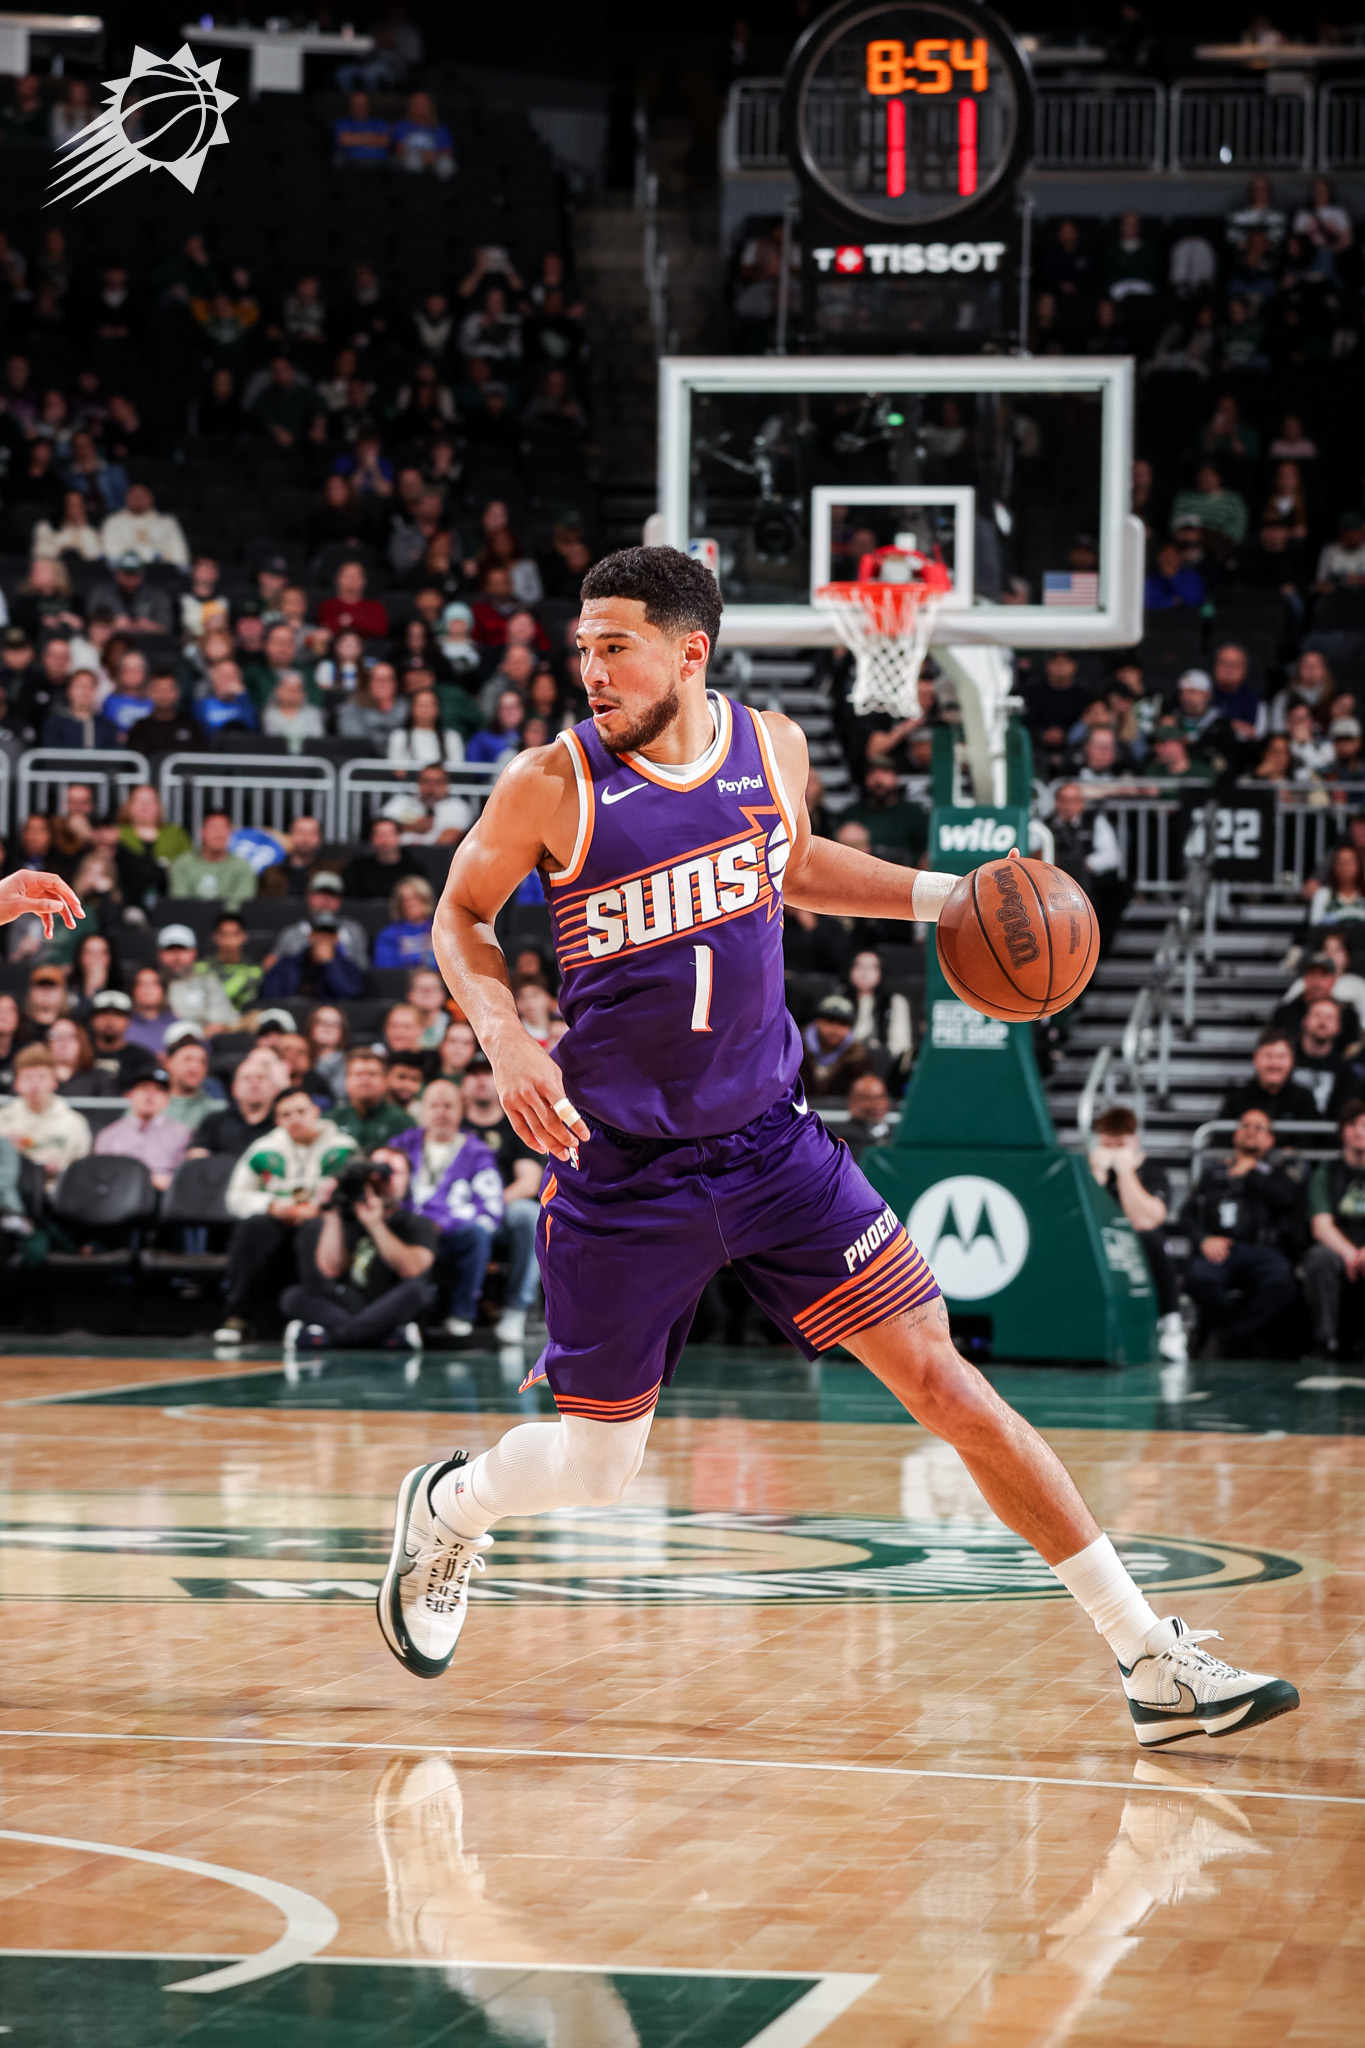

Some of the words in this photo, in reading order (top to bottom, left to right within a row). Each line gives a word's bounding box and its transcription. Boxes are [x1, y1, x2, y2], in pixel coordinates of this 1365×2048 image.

[866, 38, 989, 95] 8:54
[887, 98, 977, 198] 11
[863, 242, 1006, 274] TISSOT
[717, 775, 763, 795] PayPal
[939, 818, 1017, 852] wilo
[993, 866, 1040, 970] Wilson
[691, 944, 713, 1032] 1
